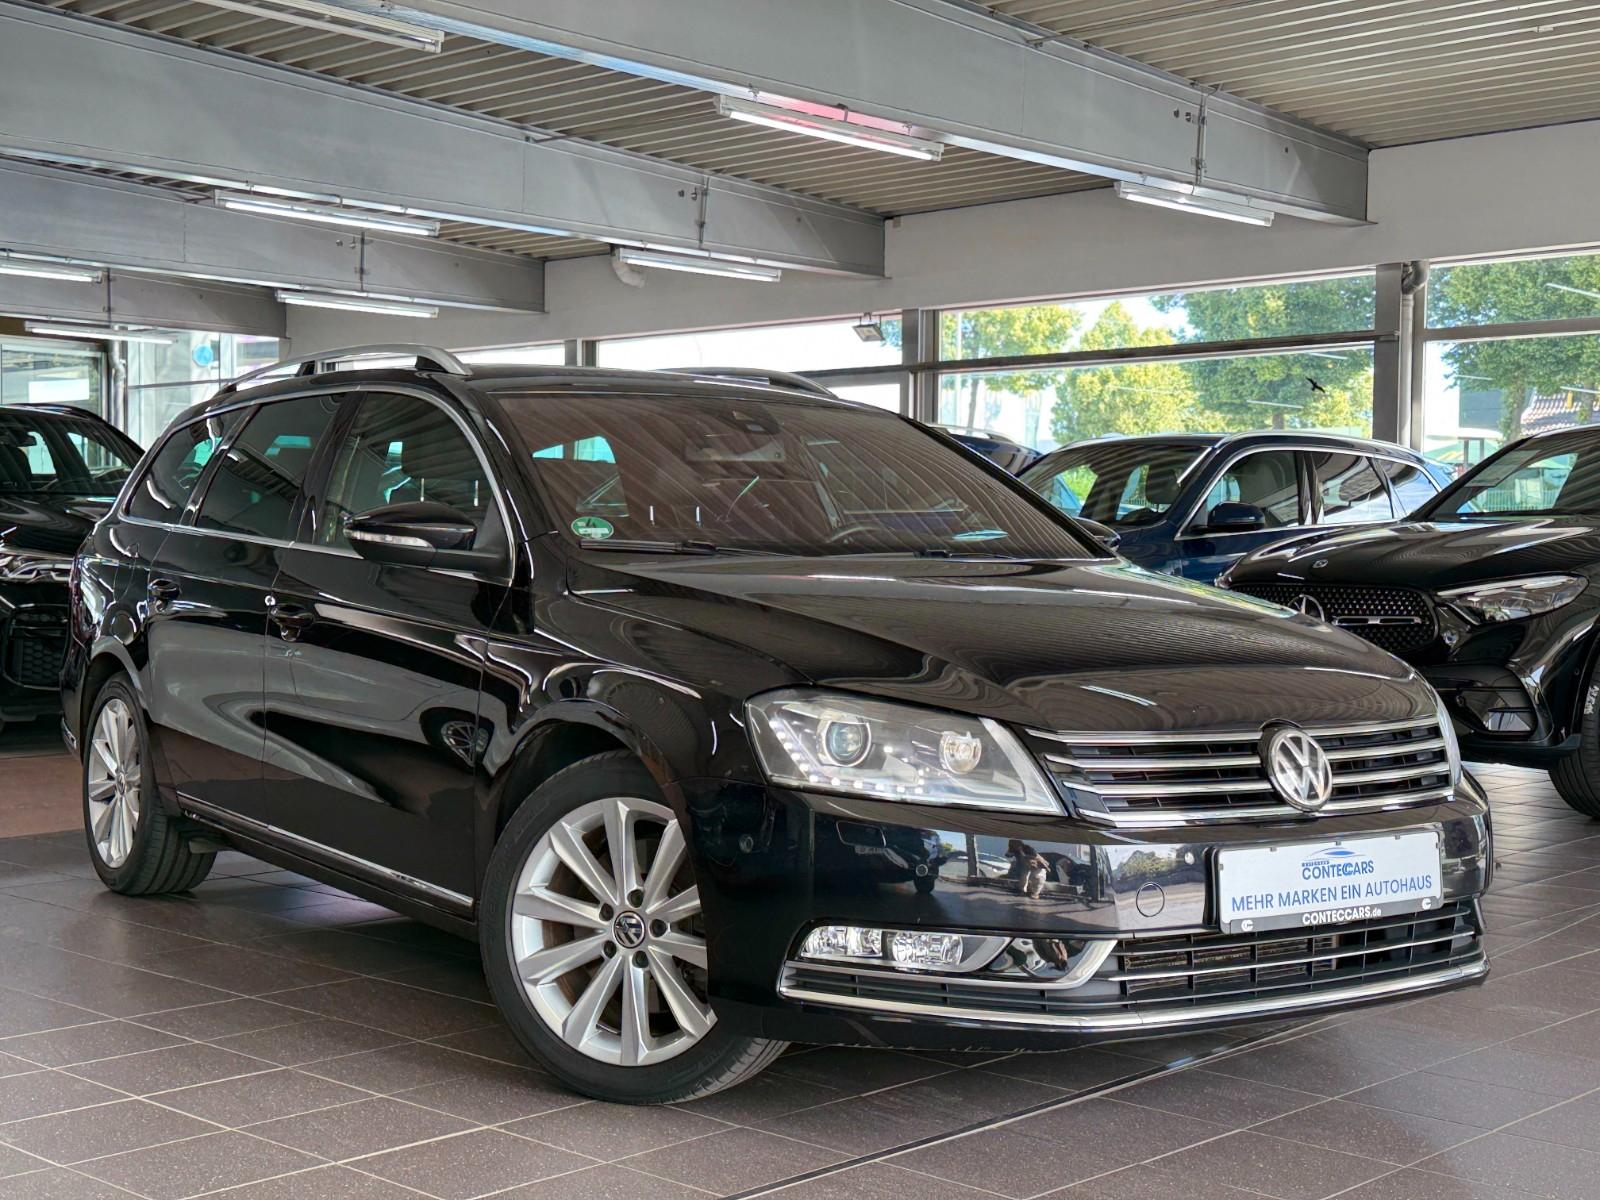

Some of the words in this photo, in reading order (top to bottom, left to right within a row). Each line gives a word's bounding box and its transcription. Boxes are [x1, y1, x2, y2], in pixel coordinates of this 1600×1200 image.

[1232, 893, 1273, 911] MEHR
[1279, 888, 1337, 907] MARKEN
[1341, 882, 1361, 900] EIN
[1366, 875, 1432, 897] AUTOHAUS
[1301, 906, 1382, 925] CONTECCARS.de
